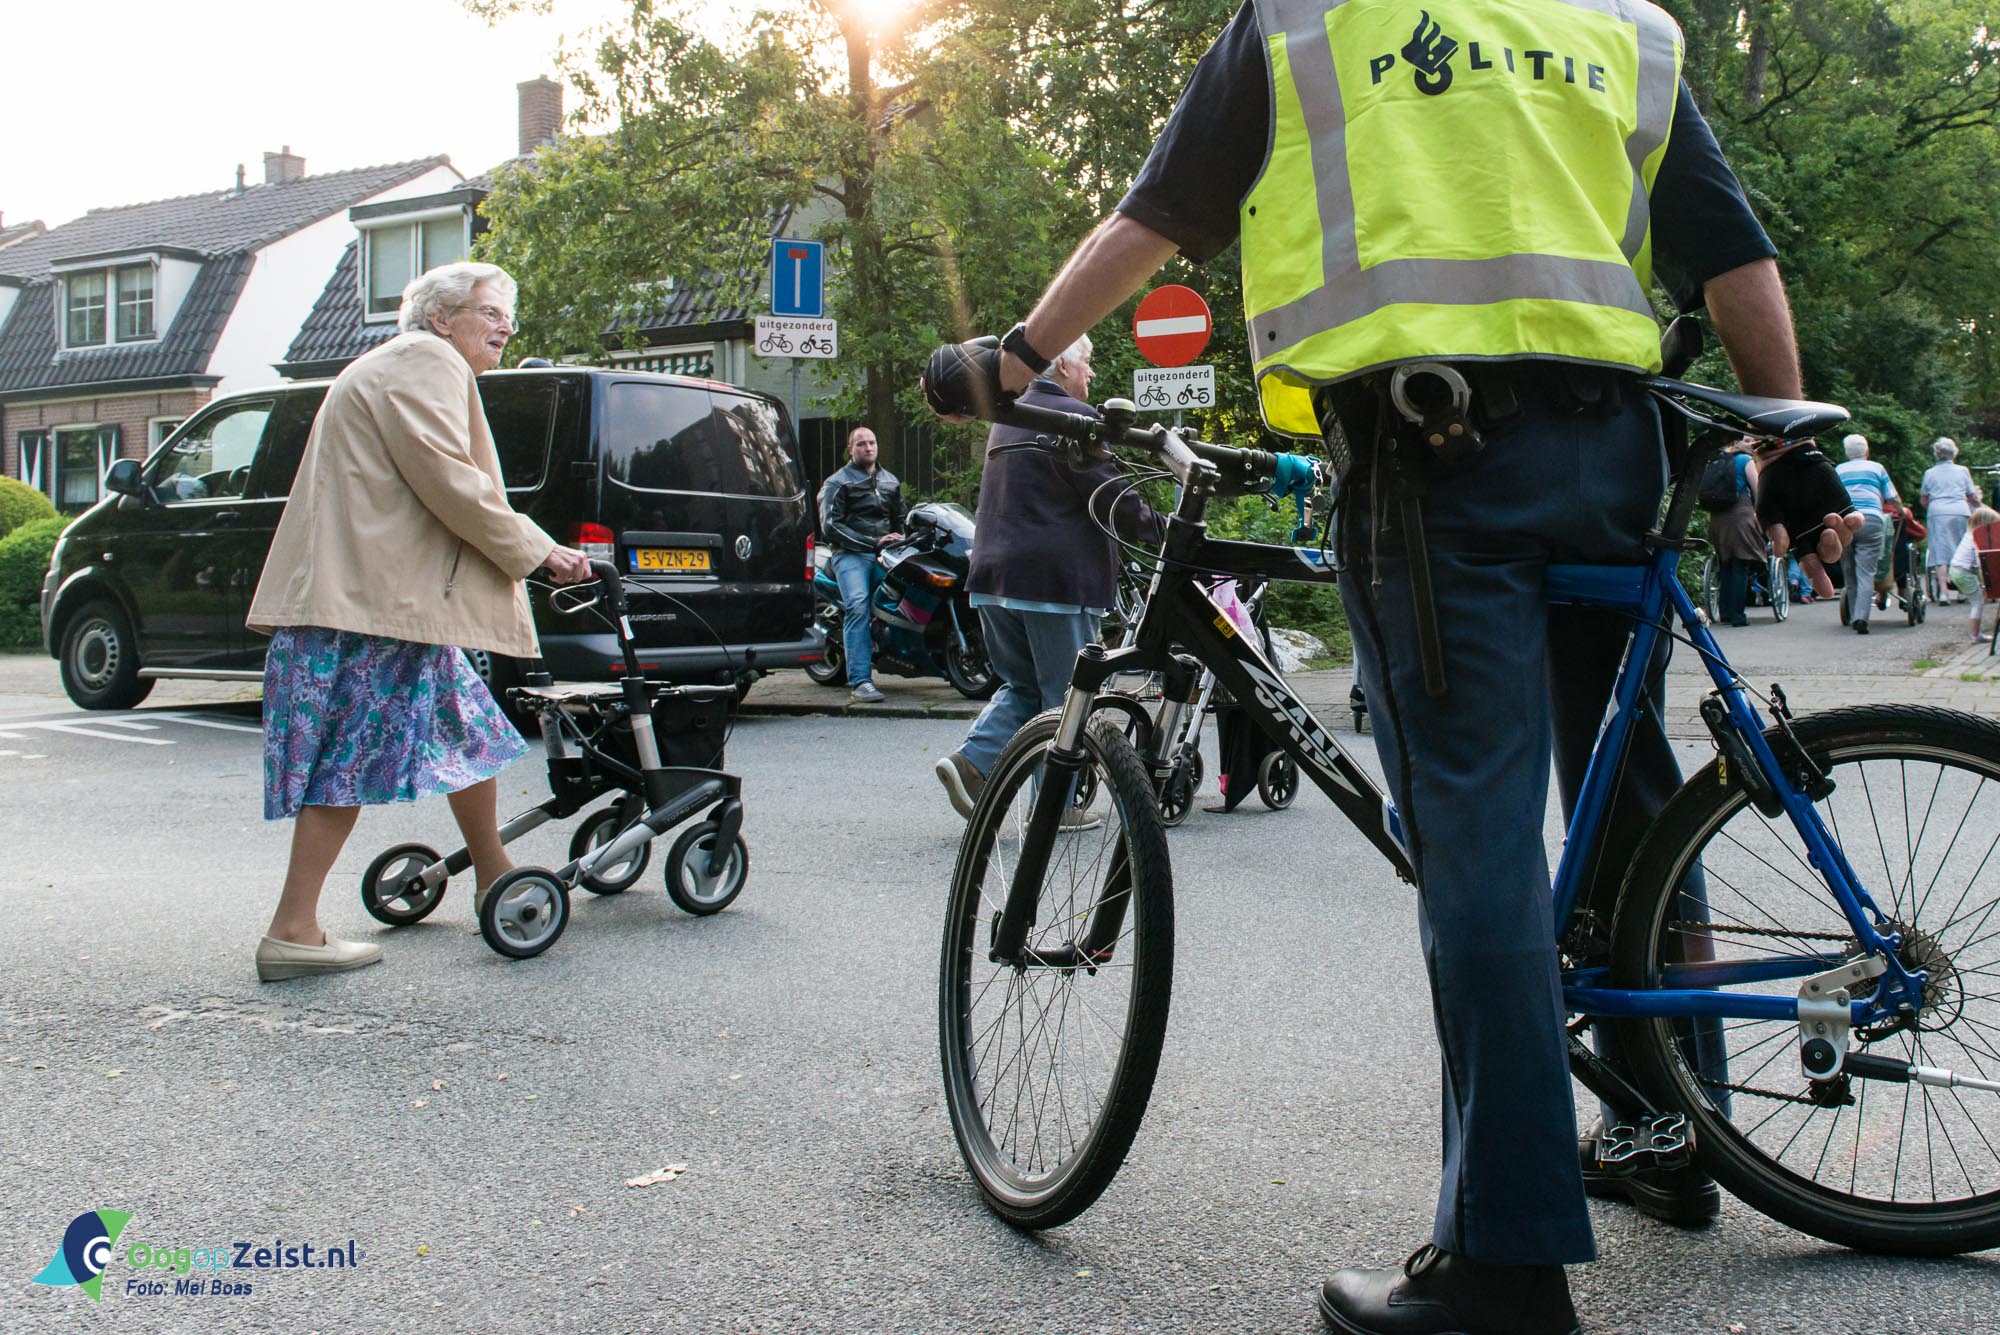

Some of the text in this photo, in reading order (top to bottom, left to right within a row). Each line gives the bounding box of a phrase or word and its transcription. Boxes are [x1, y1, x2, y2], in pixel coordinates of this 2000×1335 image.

[1369, 40, 1606, 96] POLITIE
[759, 320, 833, 332] uitgezonderd
[1137, 370, 1210, 384] uitgezonderd
[642, 551, 705, 567] 5-VZN-29
[629, 613, 677, 621] ANSPORTER
[1719, 762, 1726, 779] 2
